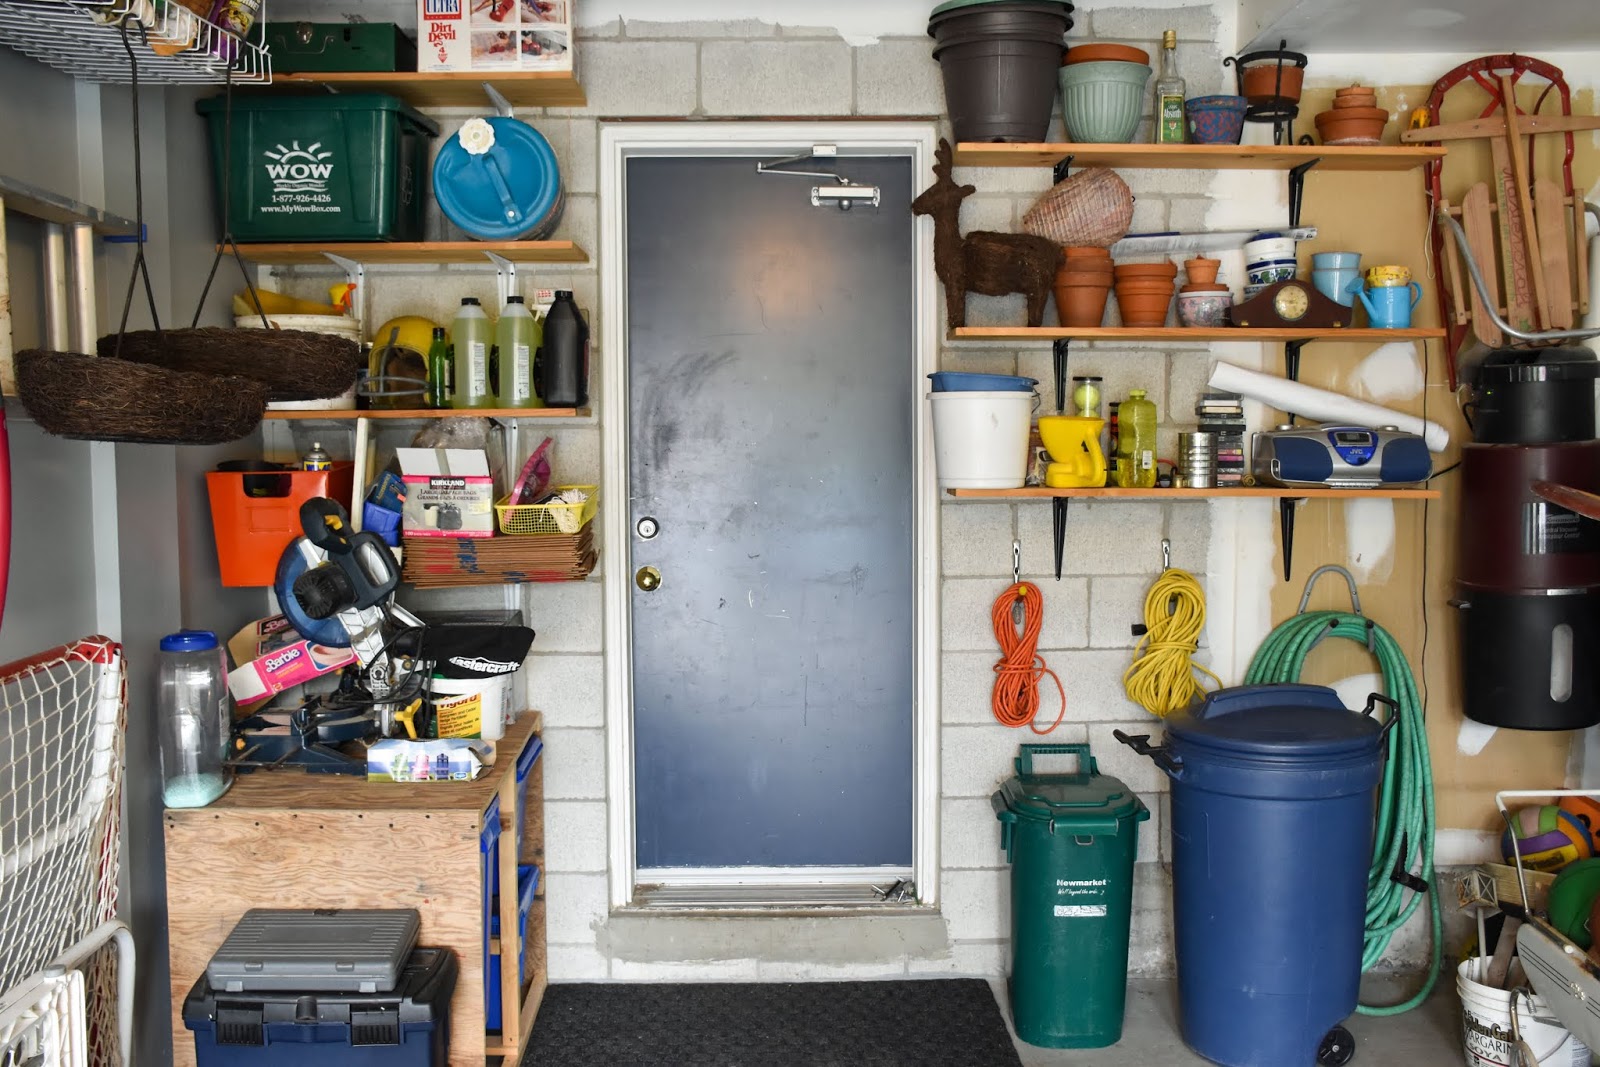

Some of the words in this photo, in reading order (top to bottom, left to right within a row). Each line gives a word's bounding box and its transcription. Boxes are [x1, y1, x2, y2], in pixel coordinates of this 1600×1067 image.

[431, 22, 452, 32] Dirt
[428, 30, 456, 43] Devil
[265, 164, 334, 179] WOW
[272, 194, 331, 202] 1-877-926-4426
[261, 205, 341, 214] www.MyWowBox.com
[265, 648, 301, 673] Barbie
[1469, 1042, 1503, 1063] SOYA
